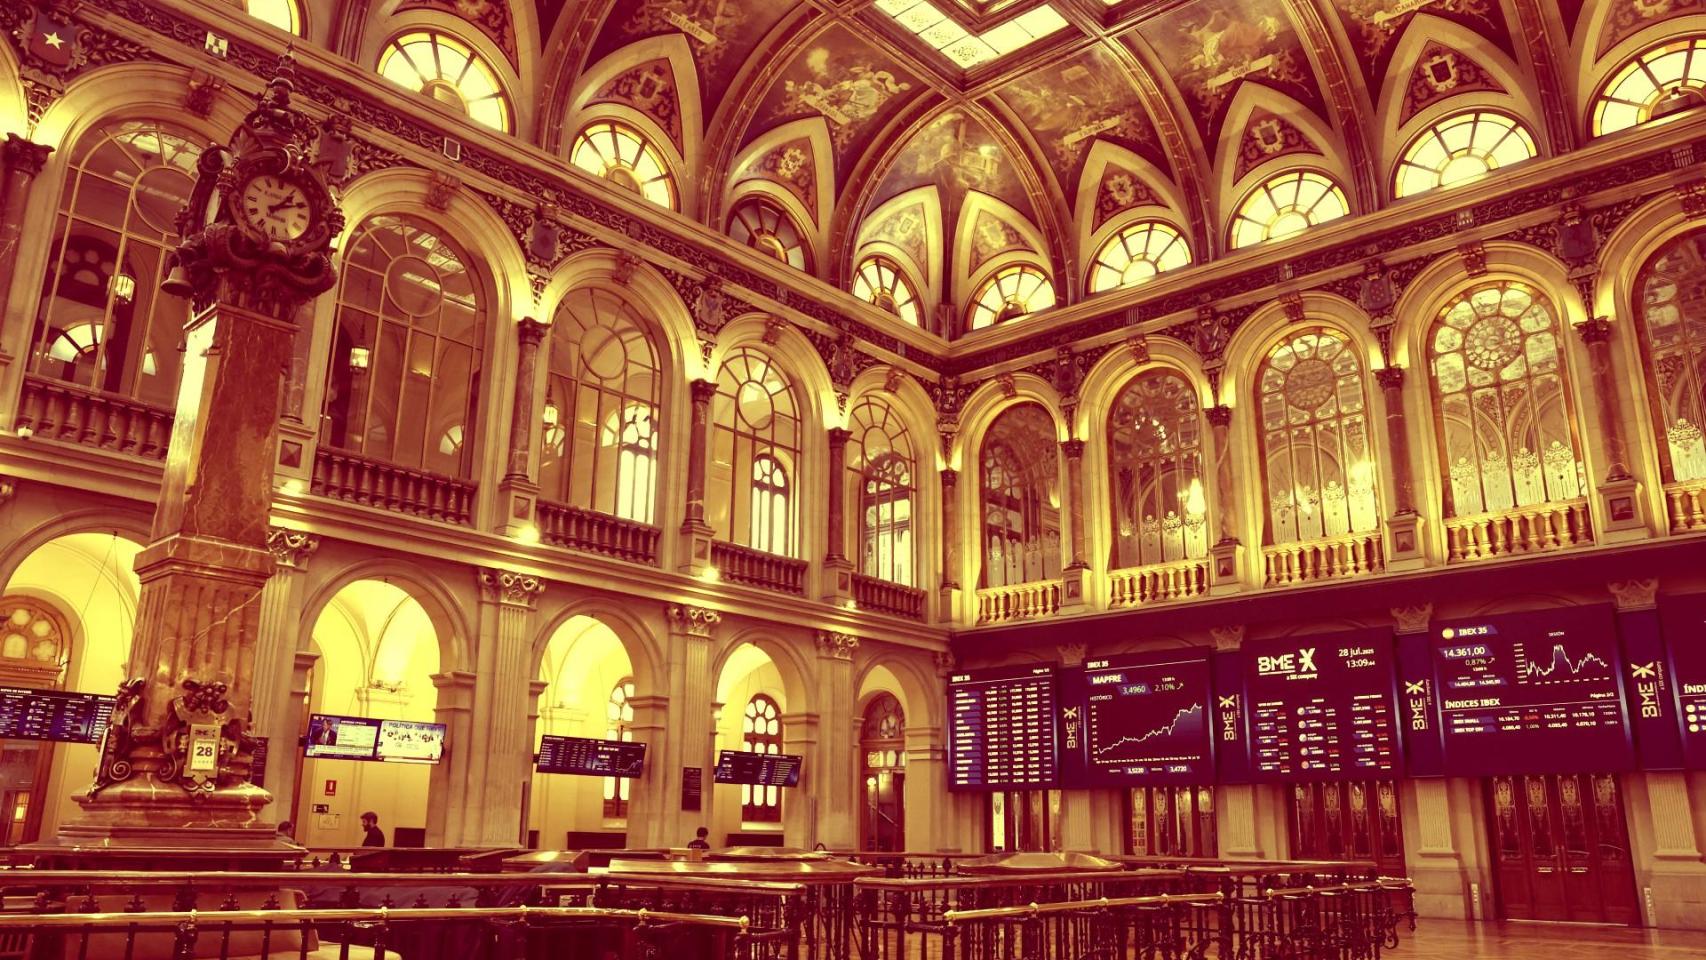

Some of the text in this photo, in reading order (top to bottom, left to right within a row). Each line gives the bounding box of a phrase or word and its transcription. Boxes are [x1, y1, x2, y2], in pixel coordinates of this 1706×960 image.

[1459, 626, 1488, 636] IBEX 35
[1338, 649, 1348, 657] 28
[1444, 646, 1486, 658] 14.361,00
[1258, 654, 1295, 672] BME
[1465, 658, 1486, 666] 0,87%
[1092, 674, 1122, 684] MAPFRE
[1122, 686, 1146, 695] 3,4960
[1445, 698, 1500, 708] ÍNDICES IBEX
[1638, 682, 1658, 718] BME
[1410, 698, 1425, 730] BME
[1222, 711, 1235, 741] BME
[1066, 722, 1076, 749] BME
[196, 746, 213, 757] 28
